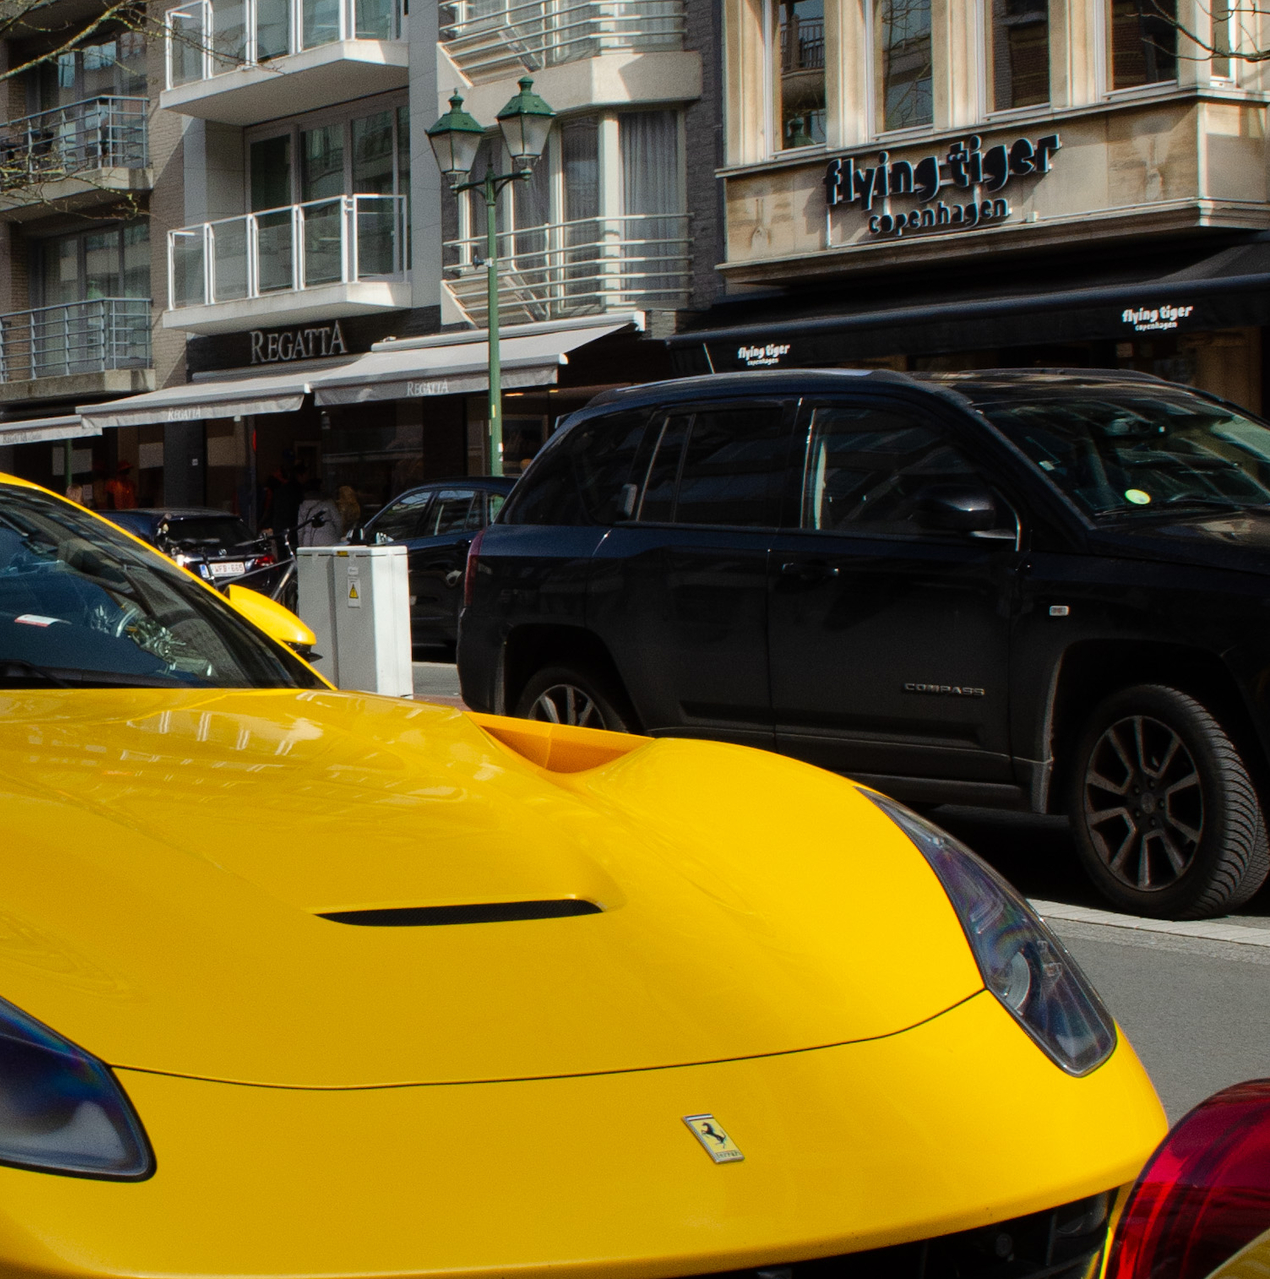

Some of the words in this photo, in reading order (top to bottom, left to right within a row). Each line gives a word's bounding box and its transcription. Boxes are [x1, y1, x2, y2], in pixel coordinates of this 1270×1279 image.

[823, 151, 940, 211] flying
[947, 134, 1061, 193] tiger
[868, 198, 1009, 236] copenhagen
[1122, 307, 1159, 325] flying
[1159, 304, 1194, 321] tiger
[1135, 321, 1178, 332] copenhagen
[249, 319, 349, 364] REGATTA
[738, 345, 765, 361] flying
[765, 343, 791, 358] tiger
[406, 379, 450, 397] REGATTA
[167, 407, 201, 422] REGATTA
[904, 682, 986, 696] COMPASS
